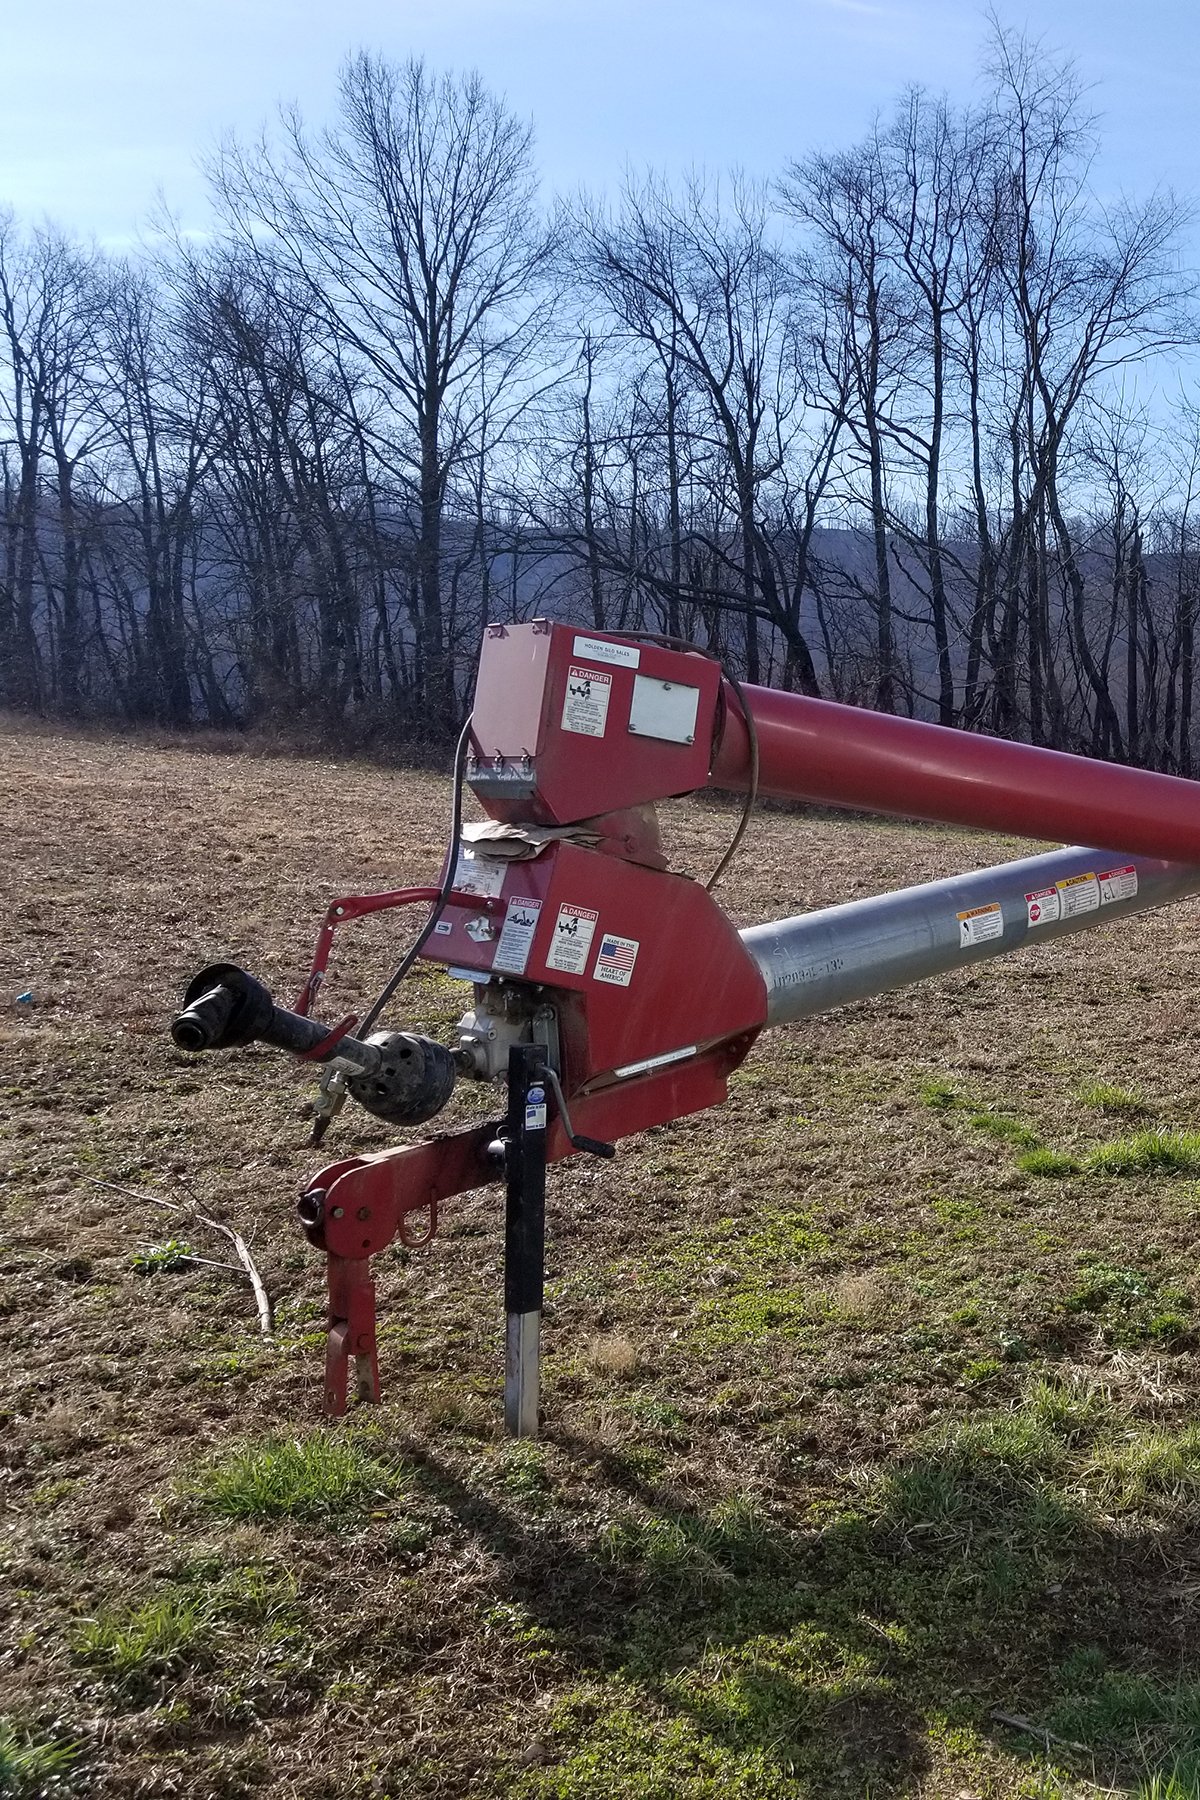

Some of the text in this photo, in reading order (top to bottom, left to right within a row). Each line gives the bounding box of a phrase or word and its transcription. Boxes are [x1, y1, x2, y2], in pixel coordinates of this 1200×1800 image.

[578, 670, 610, 683] DANGER
[1068, 875, 1088, 886] CAUTION
[1034, 889, 1053, 899] DANGER
[516, 898, 540, 909] DANGER
[568, 907, 596, 921] DANGER
[970, 905, 993, 918] WARNING
[606, 938, 619, 946] MADE
[600, 966, 618, 975] HEART
[599, 973, 624, 983] AMERICA
